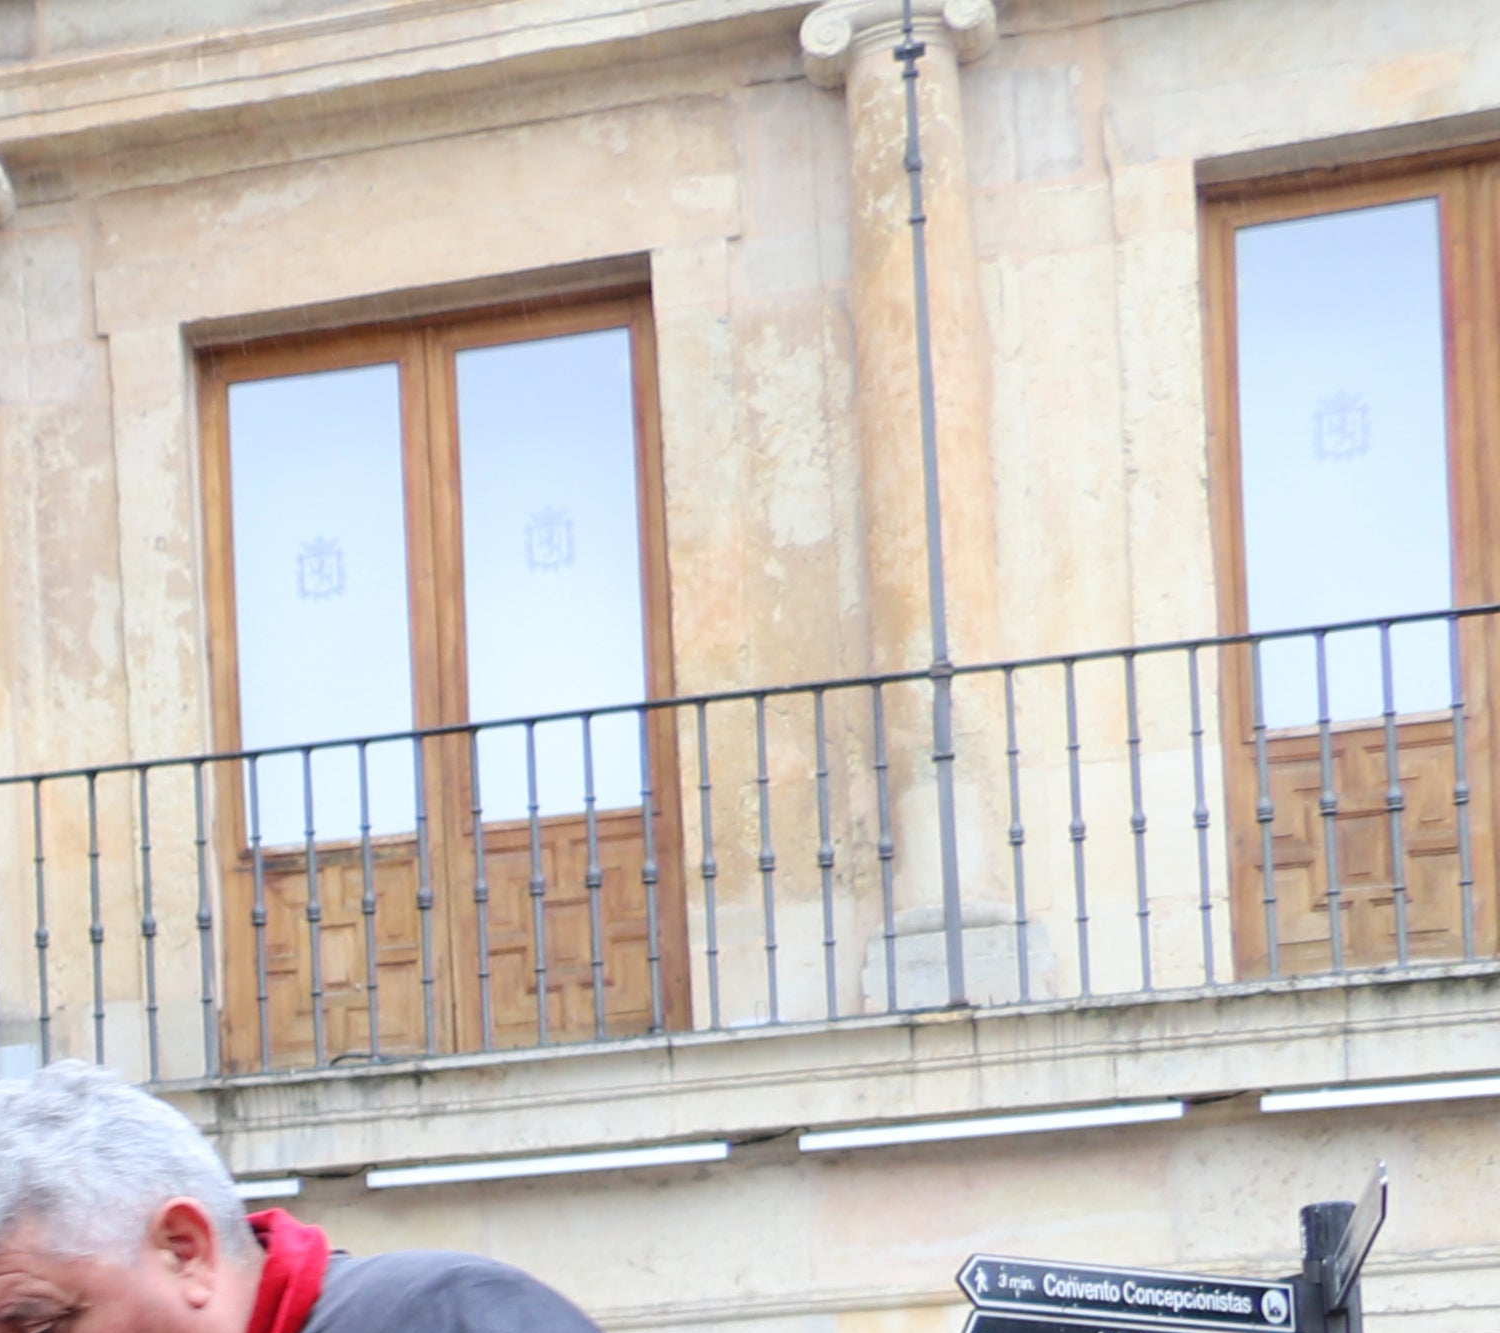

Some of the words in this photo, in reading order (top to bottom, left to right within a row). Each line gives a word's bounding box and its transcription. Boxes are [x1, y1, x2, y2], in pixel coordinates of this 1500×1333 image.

[997, 1273, 1008, 1289] 3
[1043, 1273, 1120, 1304] Convento
[1123, 1280, 1252, 1314] Concepcionistas
